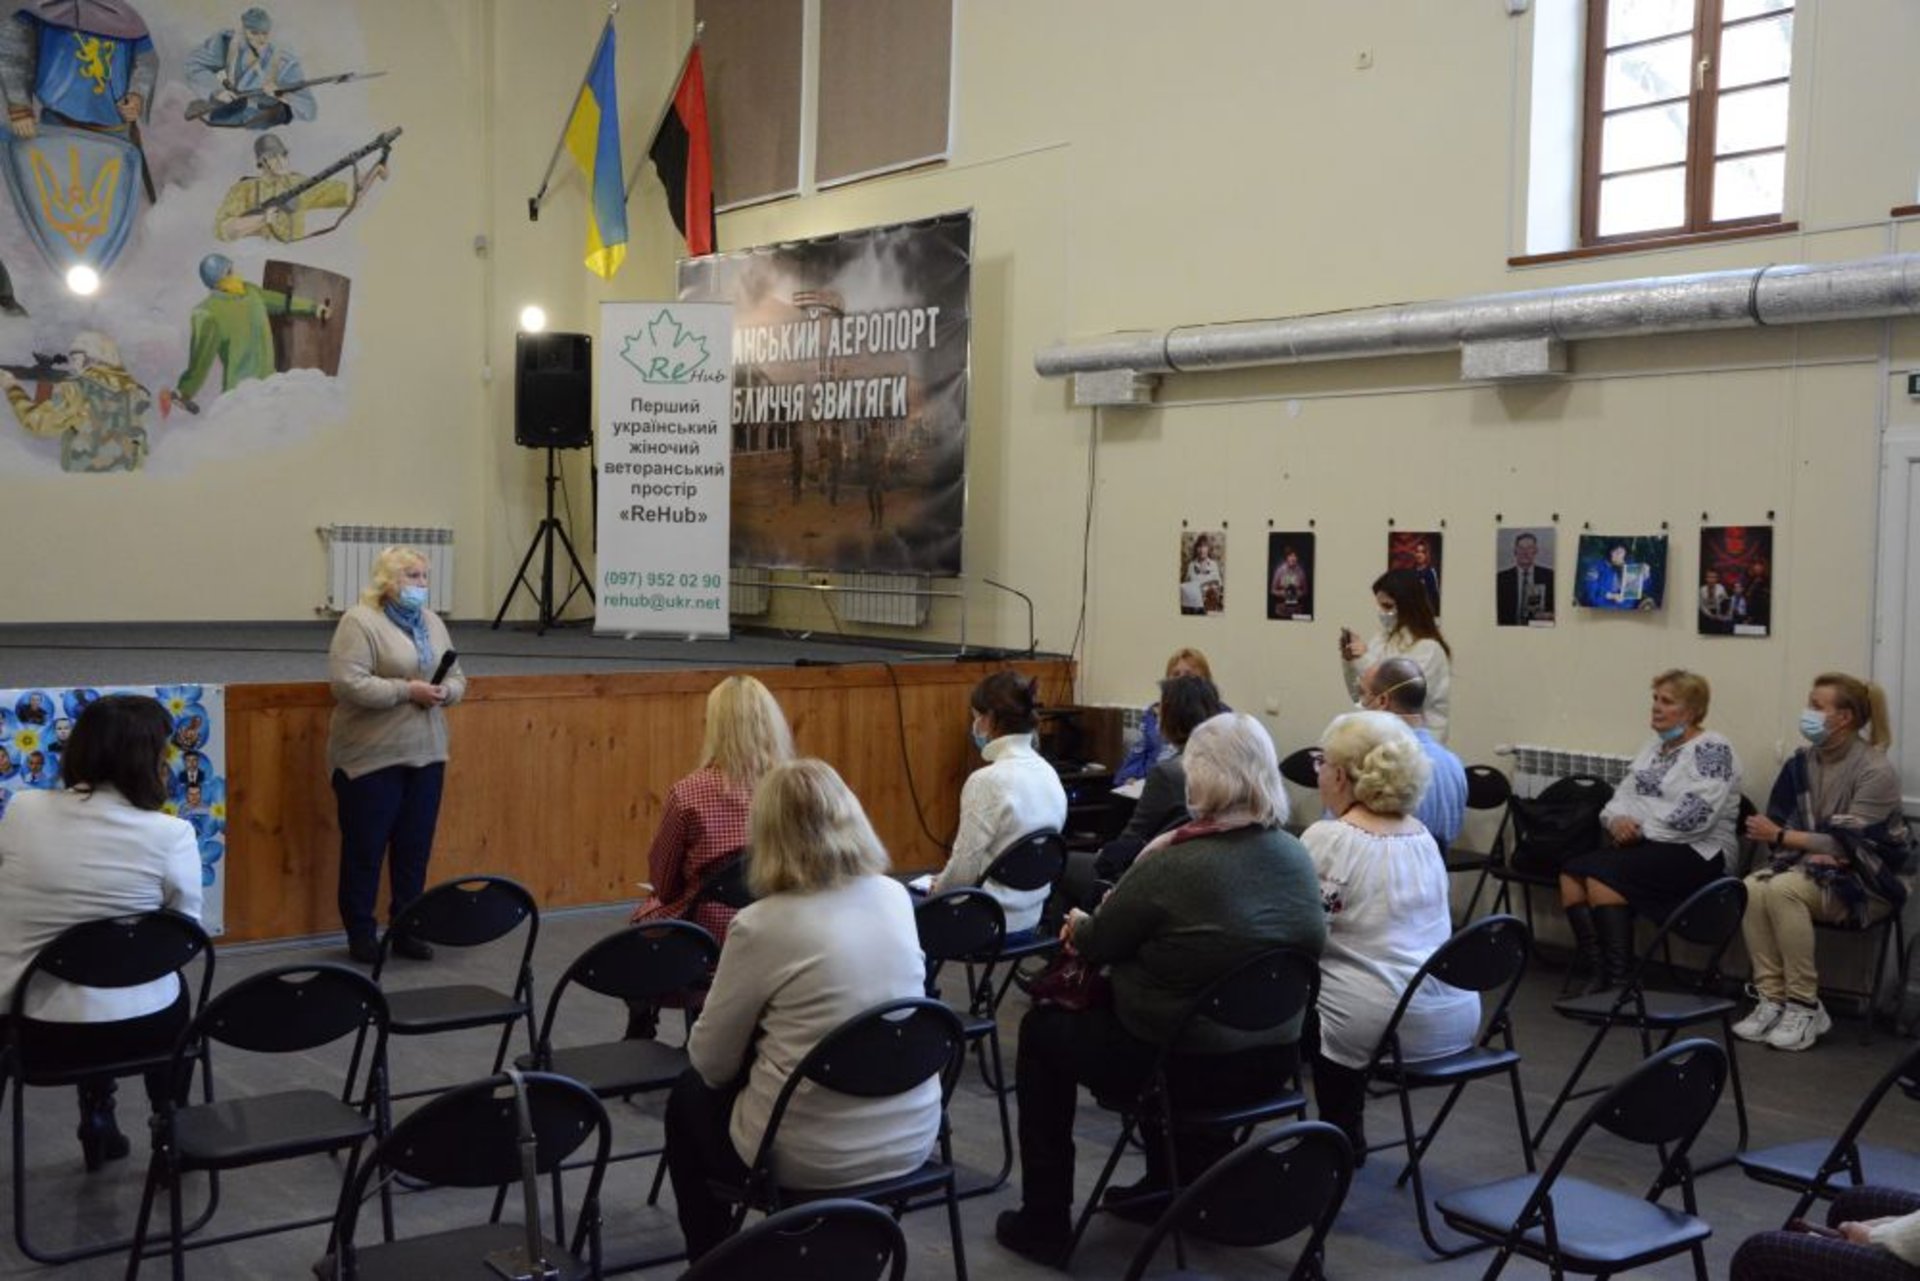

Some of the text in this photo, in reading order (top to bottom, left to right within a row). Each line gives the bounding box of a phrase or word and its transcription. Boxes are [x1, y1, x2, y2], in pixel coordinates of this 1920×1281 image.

[827, 306, 940, 358] АЕРОПОРТ
[631, 397, 700, 415] Перший
[811, 376, 907, 421] ЗВИТЯГИ
[612, 418, 718, 437] український
[629, 439, 700, 455] жіночий
[604, 461, 725, 478] ветеранський
[631, 481, 698, 500] простір
[620, 504, 708, 523] «ReHub»
[604, 571, 721, 588] (097) 952 02 90
[604, 593, 721, 611] rehub@ukr.net
